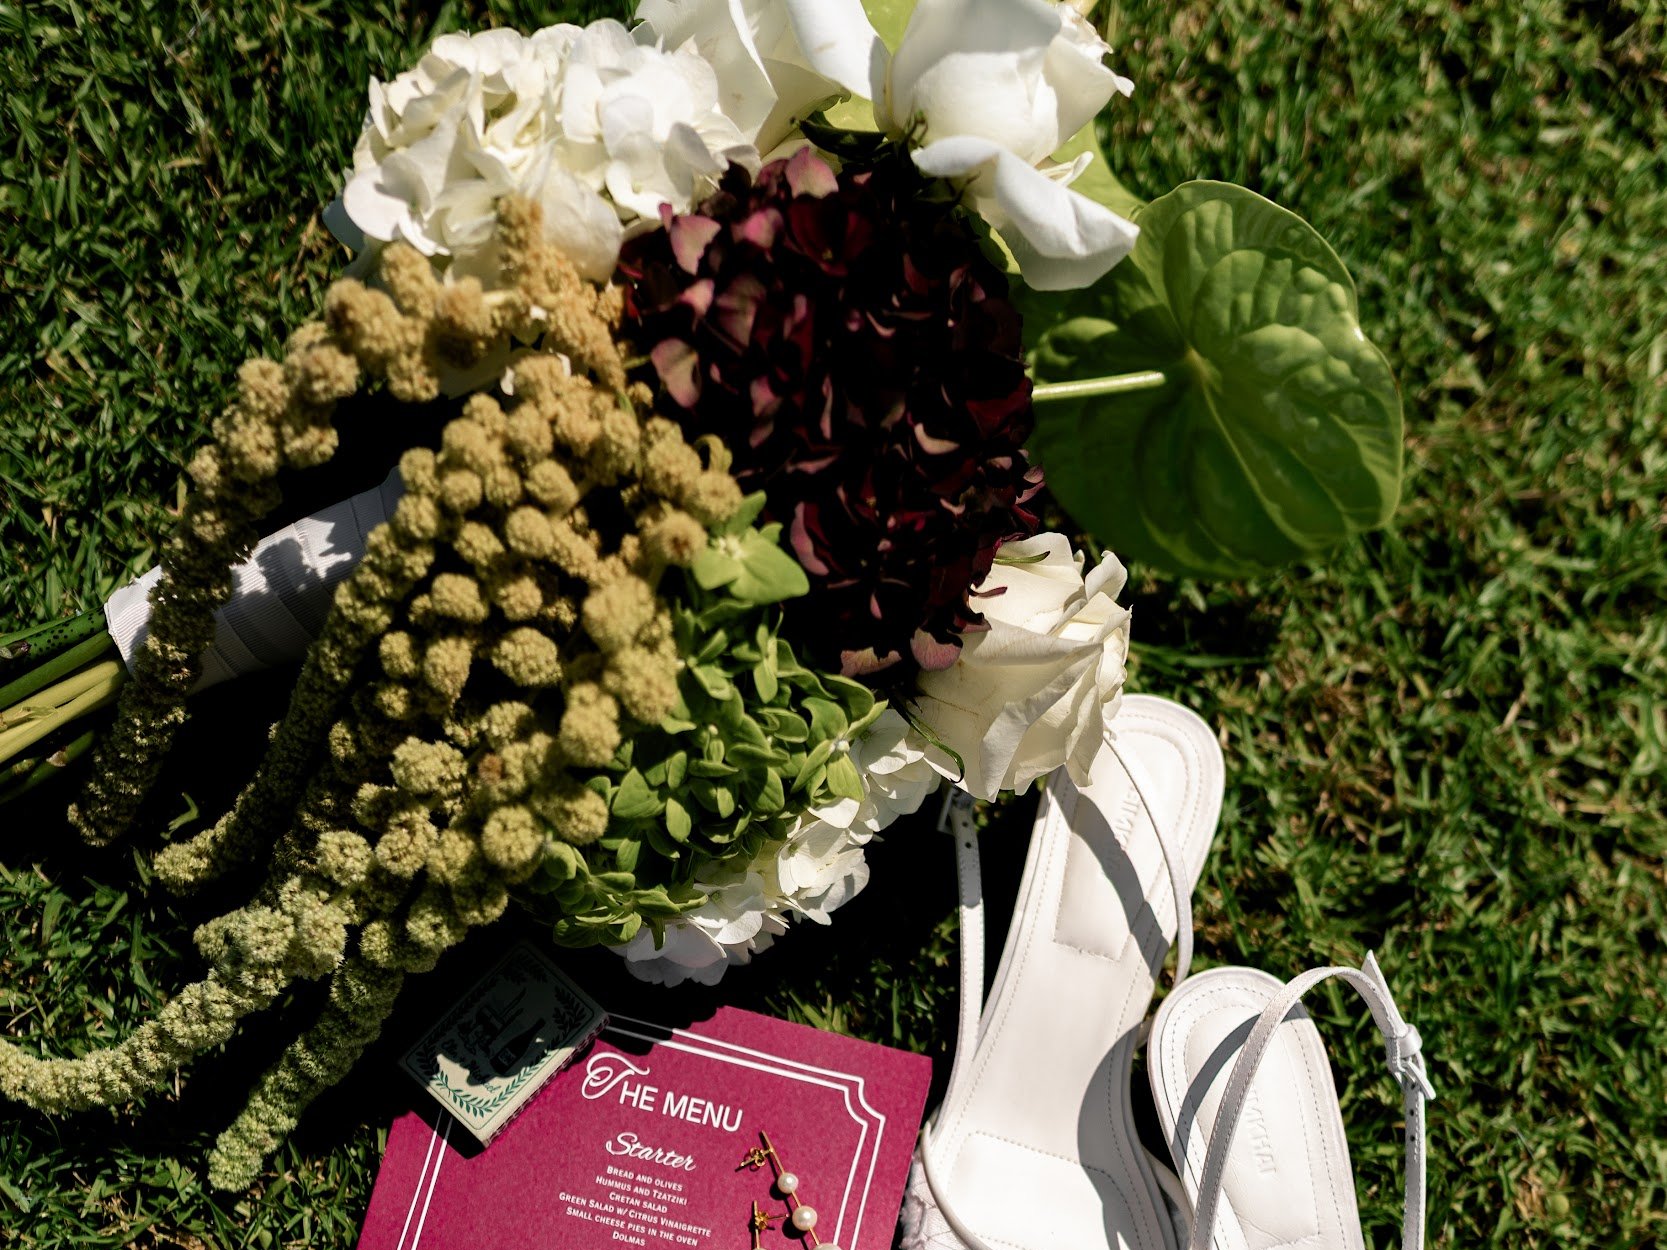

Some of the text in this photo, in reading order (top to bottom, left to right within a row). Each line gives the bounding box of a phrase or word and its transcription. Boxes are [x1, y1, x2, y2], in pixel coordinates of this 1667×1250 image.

[581, 1051, 743, 1132] THE MENU
[605, 1131, 696, 1172] Starter
